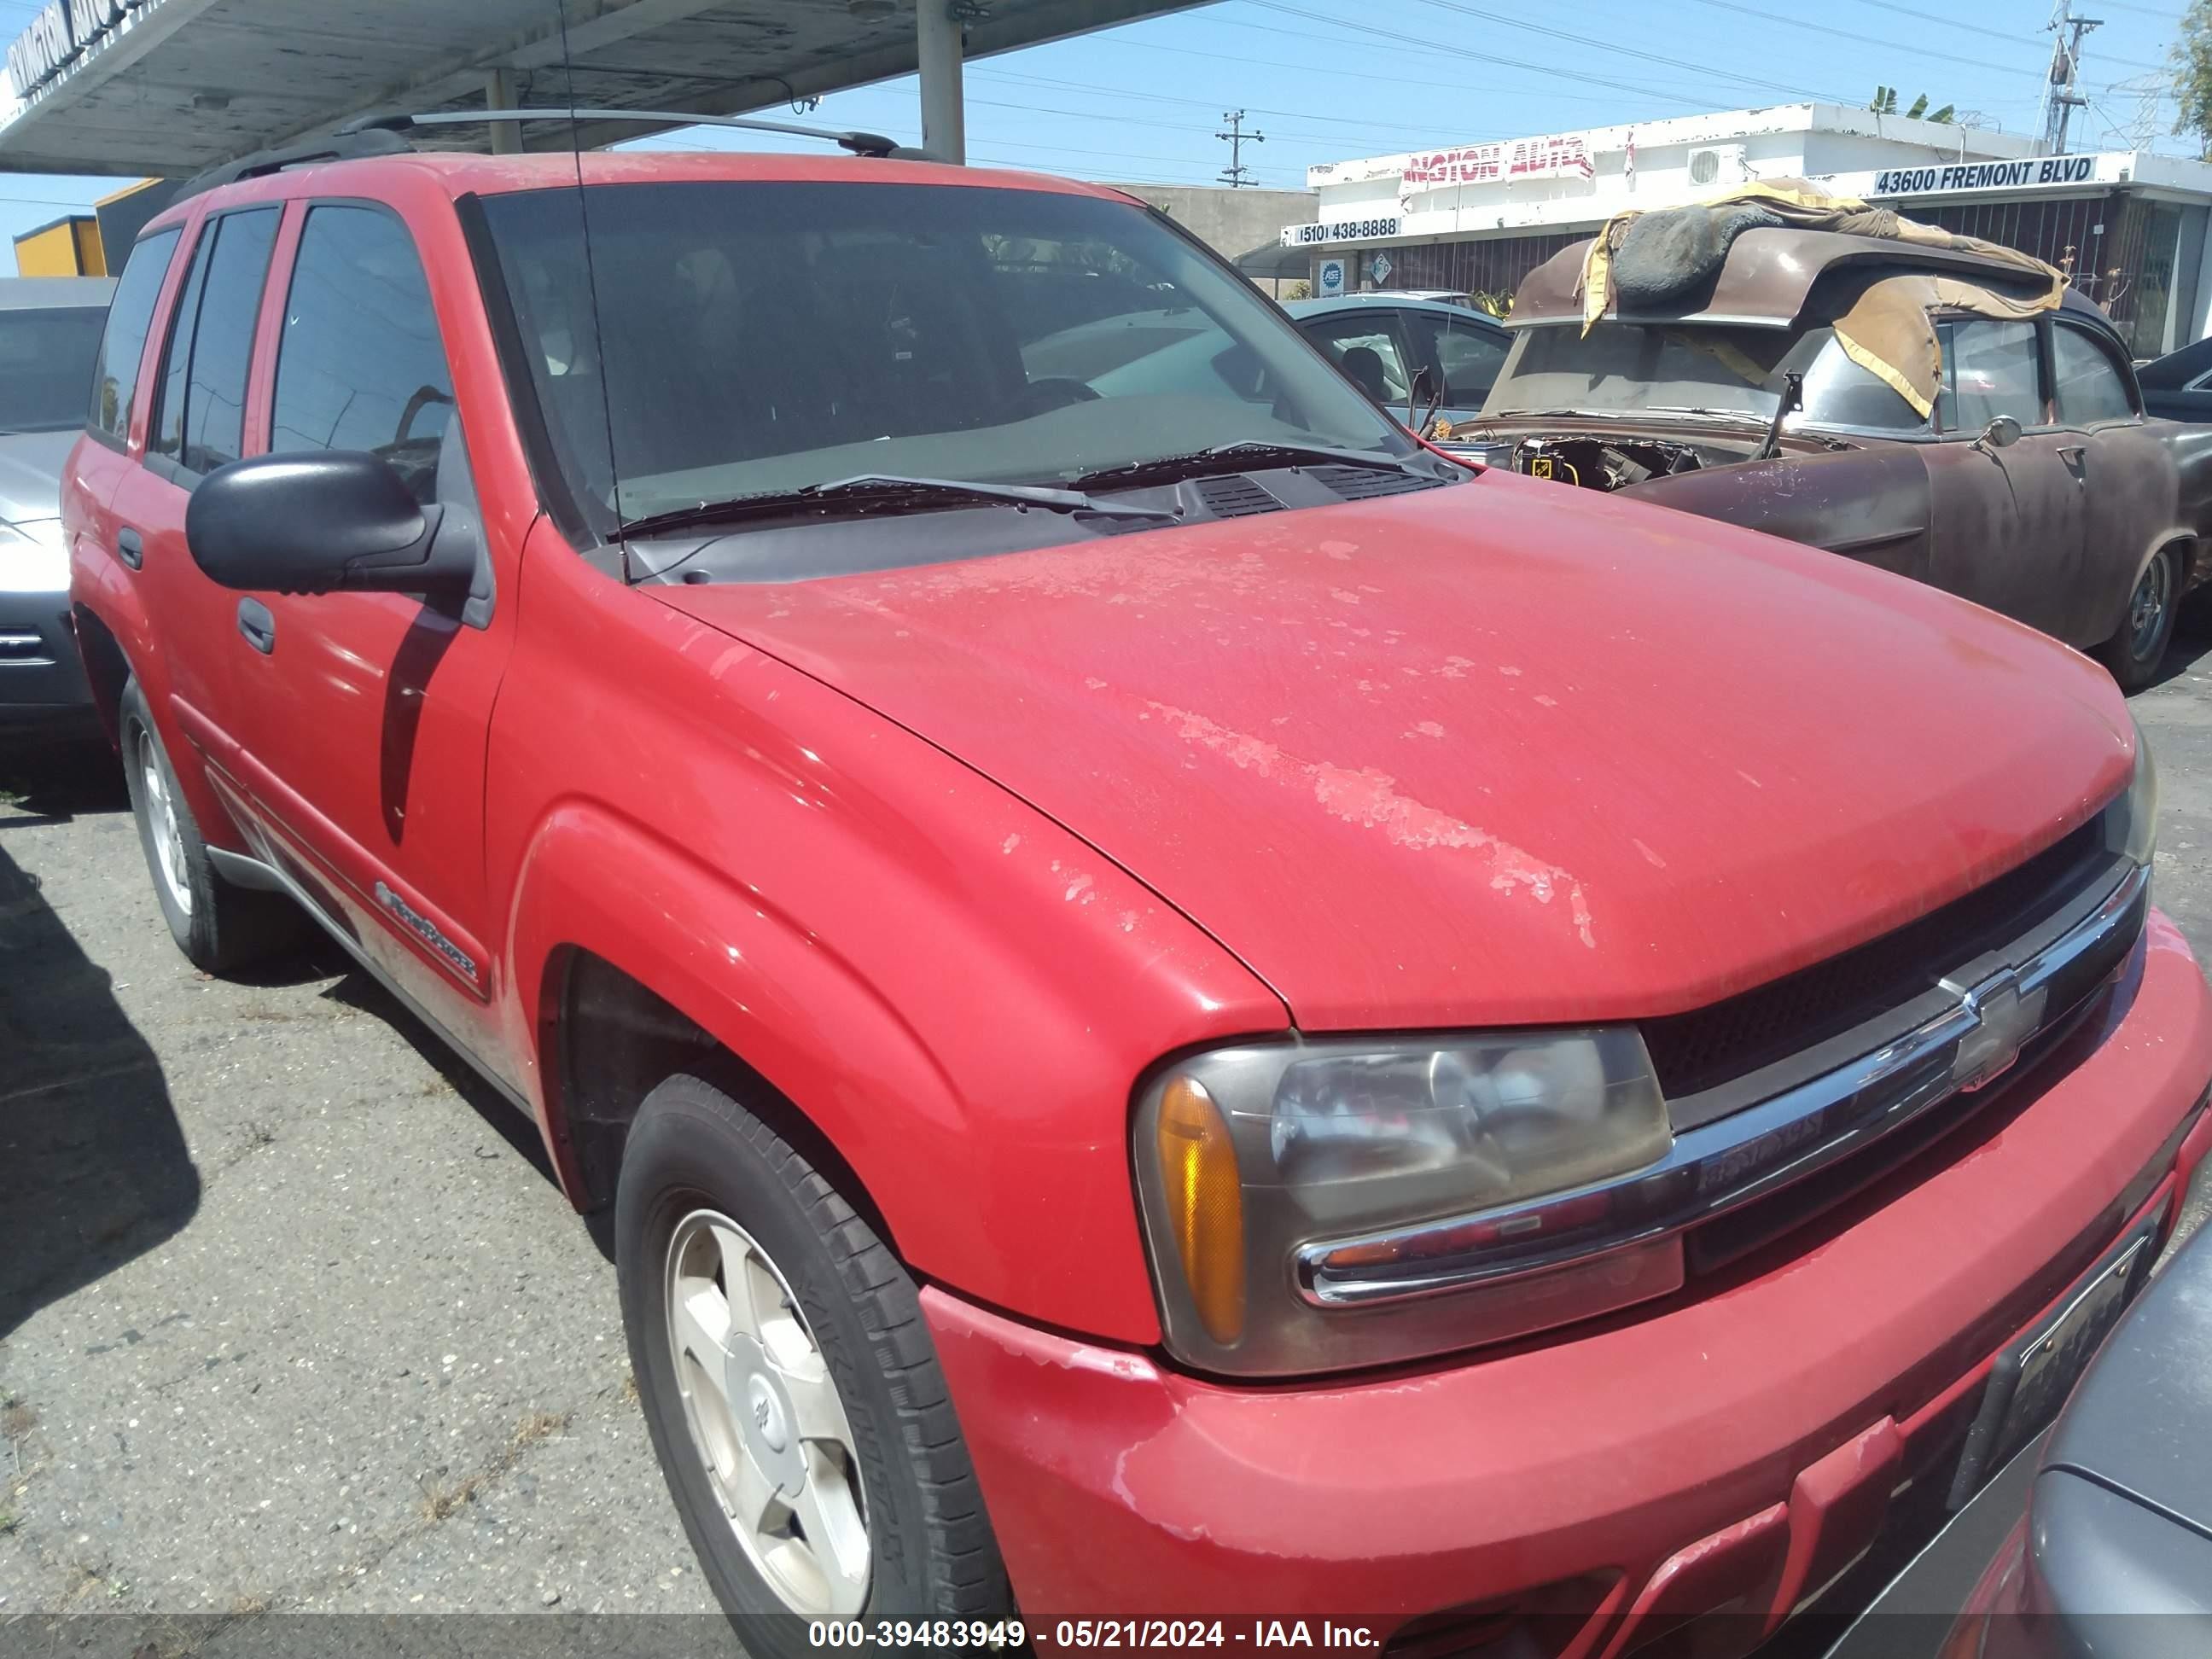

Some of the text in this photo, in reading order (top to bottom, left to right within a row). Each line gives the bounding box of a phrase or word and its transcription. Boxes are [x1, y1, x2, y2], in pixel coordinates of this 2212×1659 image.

[1877, 157, 2091, 195] 43600 FREMONT BLVD
[1332, 218, 1397, 240] 438-8888
[1324, 270, 1340, 281] ASE
